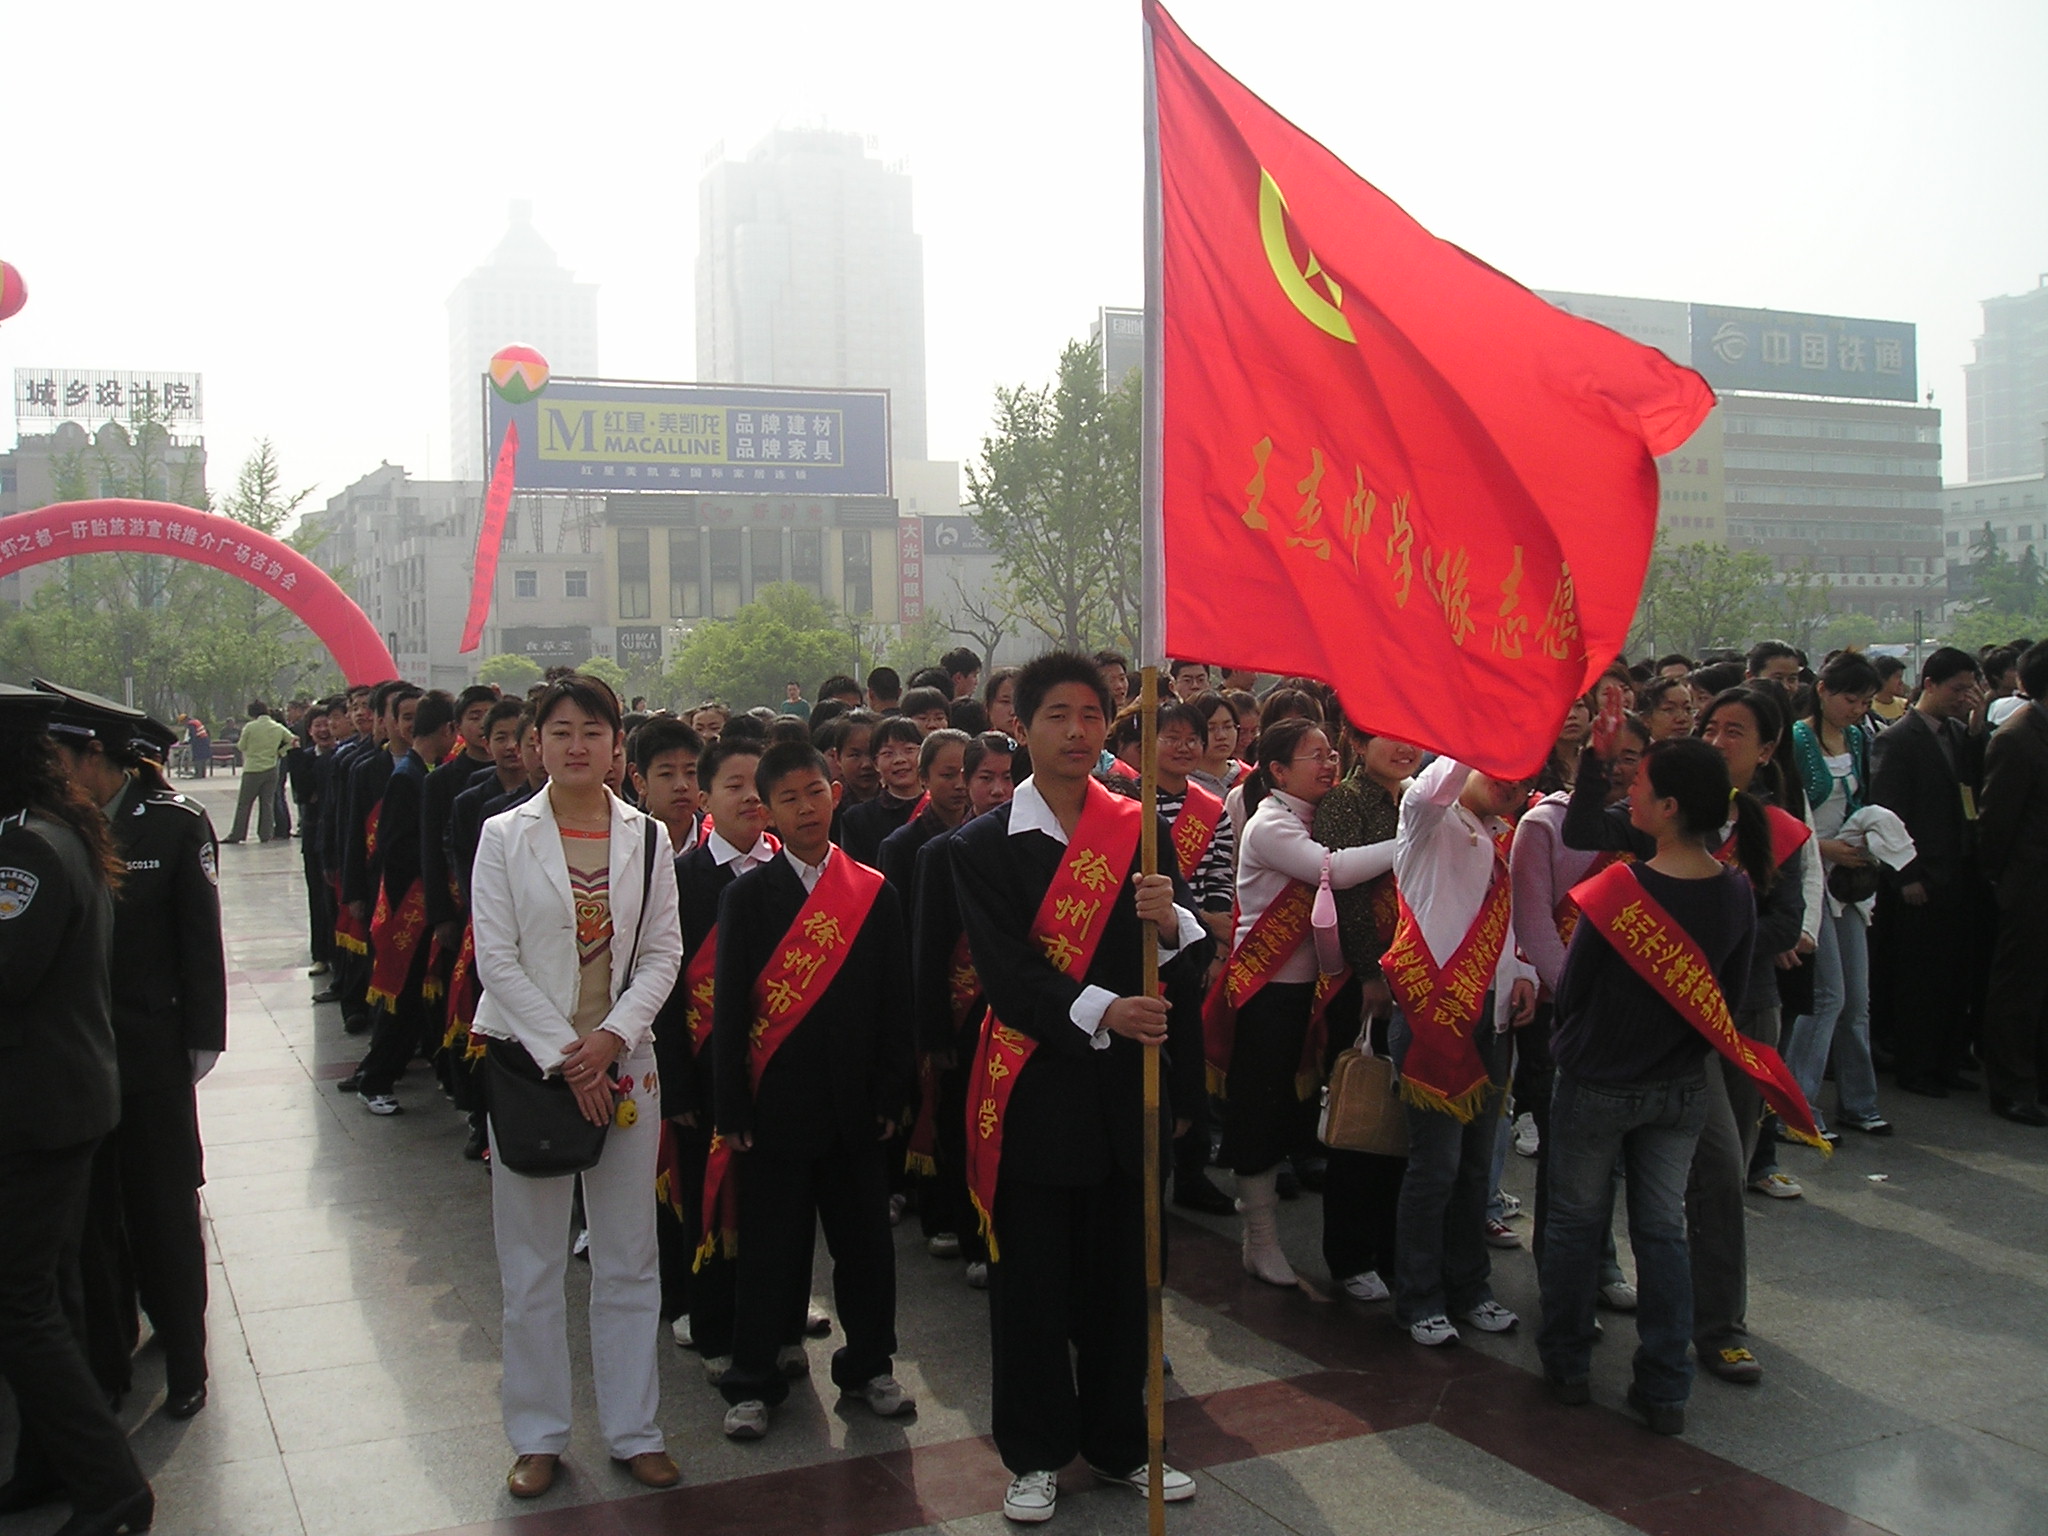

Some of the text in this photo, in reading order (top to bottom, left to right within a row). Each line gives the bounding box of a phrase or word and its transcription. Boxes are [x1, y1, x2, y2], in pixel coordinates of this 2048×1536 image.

[1761, 330, 1903, 374] 中国铁通
[27, 379, 193, 410] 城乡设计院
[545, 408, 598, 452] M
[735, 412, 832, 436] 品牌建材
[604, 435, 721, 456] MACALLINE
[735, 437, 832, 461] 品牌家具
[581, 465, 808, 481] 红星美凯龙国际家居连锁
[903, 524, 920, 617] 大光明眼镜
